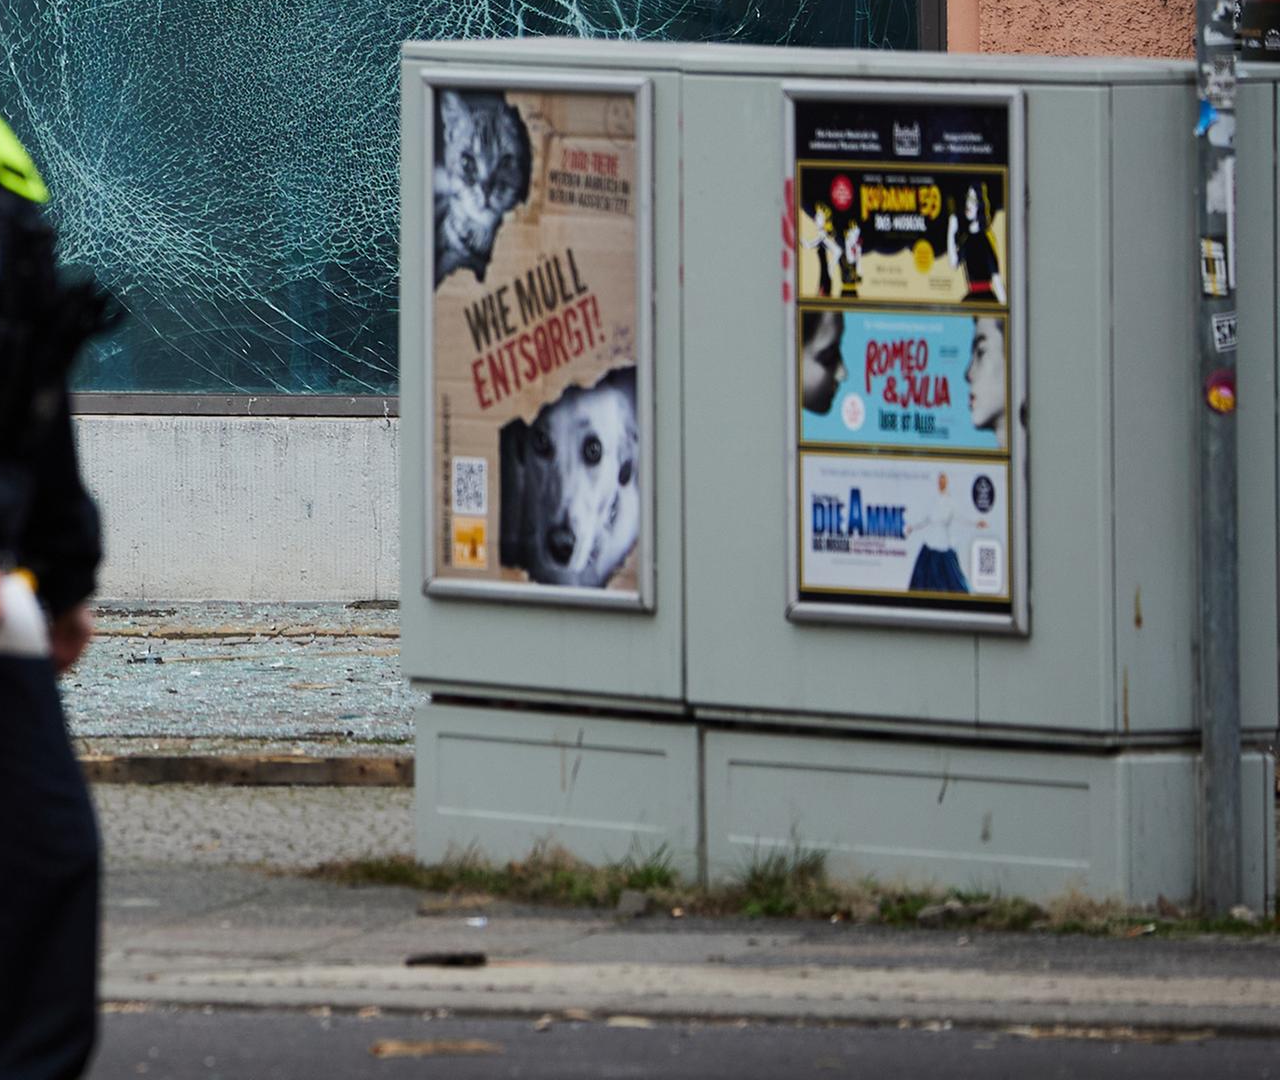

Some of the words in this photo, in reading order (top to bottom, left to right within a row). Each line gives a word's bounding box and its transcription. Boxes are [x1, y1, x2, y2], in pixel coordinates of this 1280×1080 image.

[917, 184, 942, 221] 59
[464, 283, 516, 352] WIE
[516, 247, 589, 325] MÜLL
[472, 294, 607, 410] ENTSORGT!
[865, 339, 929, 395] ROMEO
[883, 379, 901, 405] &
[900, 375, 952, 409] JULIA
[812, 501, 845, 537] DIE
[848, 487, 908, 540] AMME
